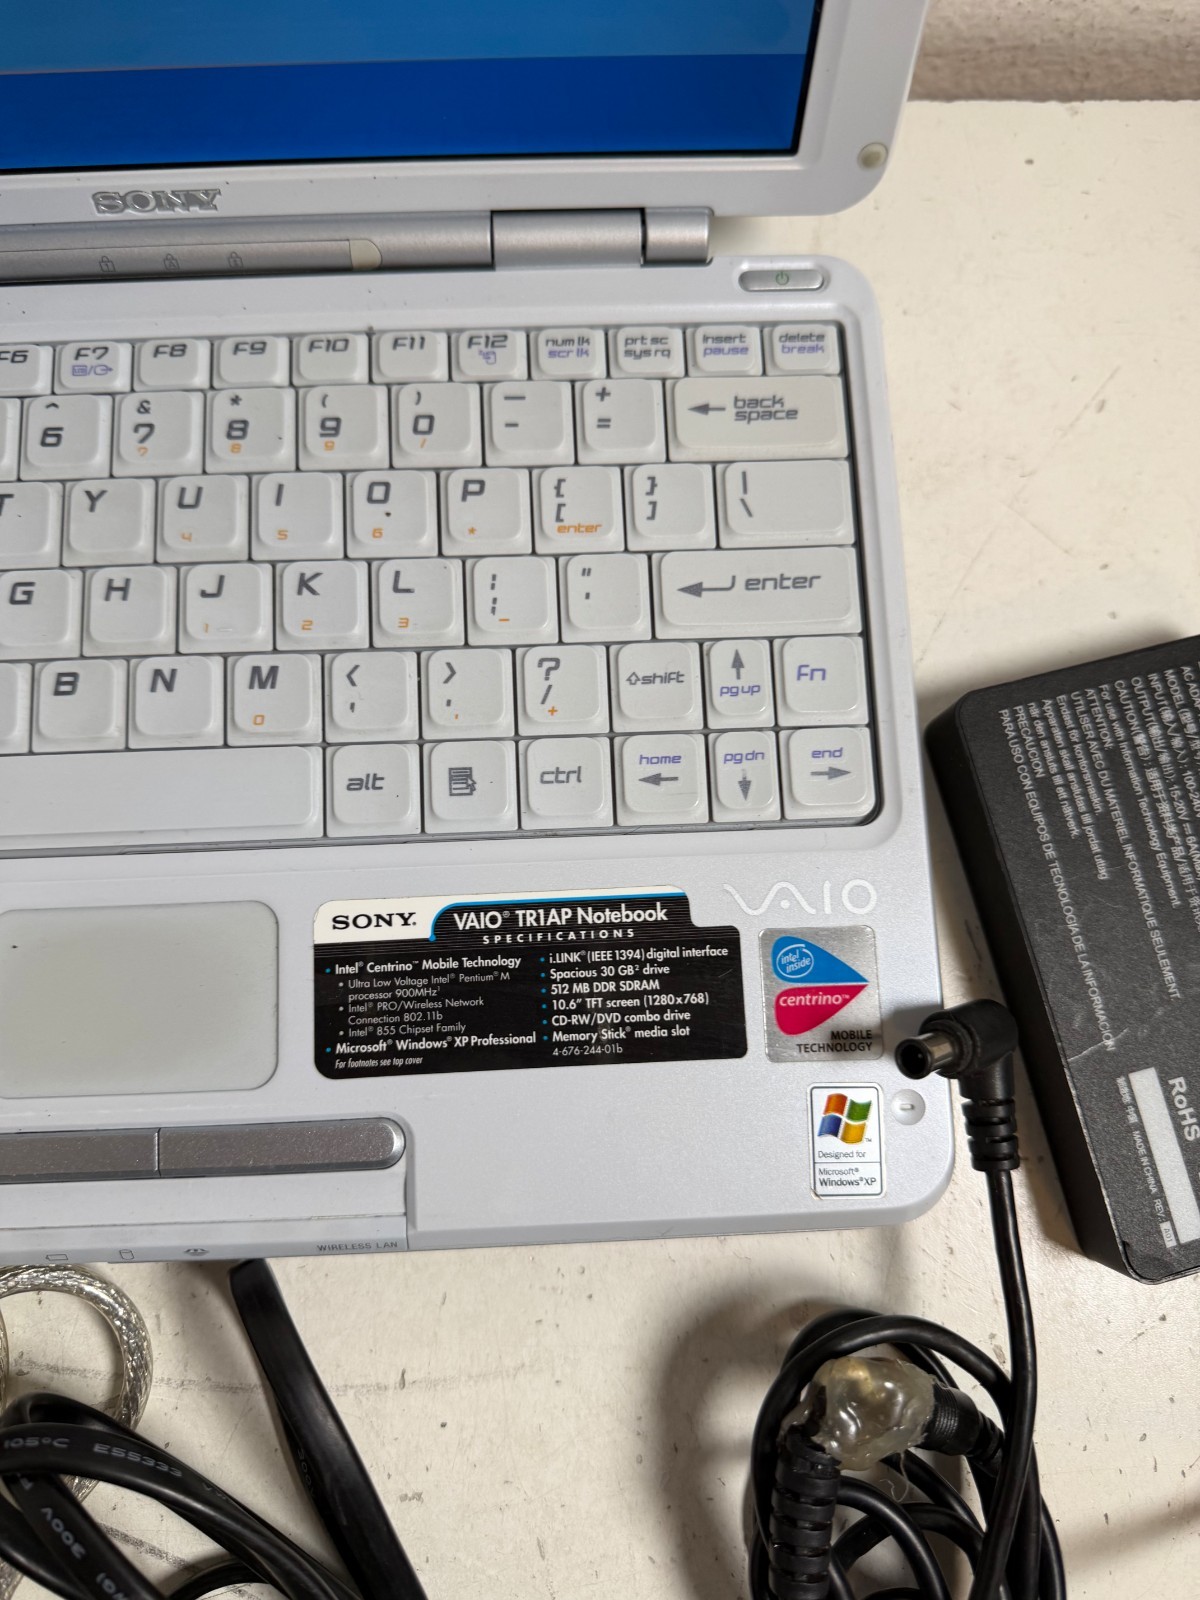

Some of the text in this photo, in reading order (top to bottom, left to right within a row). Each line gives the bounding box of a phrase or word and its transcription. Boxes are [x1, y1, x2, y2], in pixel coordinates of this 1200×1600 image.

[92, 189, 220, 214] SONY
[308, 339, 349, 352] F10
[393, 337, 426, 350] F11
[467, 335, 509, 349] F12
[545, 336, 591, 347] num lk
[624, 336, 669, 347] prt sc
[702, 333, 746, 344] insert
[779, 333, 825, 343] delete
[75, 347, 109, 361] F7
[153, 344, 187, 357] F8
[233, 342, 267, 355] F9
[548, 347, 590, 358] scr lk
[624, 348, 671, 360] sys rq
[703, 346, 749, 357] pause
[781, 343, 825, 353] break
[734, 395, 784, 409] back
[735, 408, 798, 424] space
[133, 423, 155, 443] 7
[226, 420, 249, 440] 8
[319, 417, 341, 437] 9
[41, 427, 64, 448] 6
[177, 487, 202, 509] U
[461, 479, 485, 501] P
[84, 490, 107, 512] Y
[557, 523, 601, 534] enter
[105, 578, 131, 601] H
[200, 575, 225, 598] J
[297, 572, 322, 595] K
[745, 573, 821, 591] enter
[9, 582, 35, 605] G
[150, 669, 177, 692] N
[248, 666, 278, 689] M
[641, 671, 685, 685] shift
[796, 665, 826, 681] Fn
[53, 672, 79, 696] B
[719, 683, 761, 697] pg up
[1099, 684, 1112, 701] For
[1071, 691, 1094, 740] UTILISER
[1105, 702, 1117, 719] use
[1112, 721, 1127, 740] with
[1013, 705, 1045, 778] PRECAUCION
[639, 754, 682, 766] home
[723, 749, 764, 764] pg dn
[812, 747, 843, 759] end
[1087, 740, 1104, 770] AVEC
[540, 767, 582, 785] ctrl
[1118, 741, 1145, 795] Information
[346, 773, 384, 791] alt
[1097, 770, 1111, 788] DU
[1103, 788, 1129, 843] MATERIEL
[1134, 795, 1164, 852] Technology
[998, 709, 1117, 1051] PARA USO CON EQUIPOS DE TECNOLOGIA DE LA INFORMACION
[1121, 843, 1157, 929] INFORMATIQUE
[723, 879, 877, 915] VAIO
[516, 908, 572, 927] TR1AP
[577, 902, 668, 924] Notebook
[482, 928, 634, 944] SPECIFICATIONS
[588, 951, 613, 963] (IEEE
[616, 949, 645, 960] 1394)
[647, 947, 680, 960] digital
[682, 945, 728, 958] interface
[780, 951, 800, 965] intel
[422, 958, 459, 970] Mobile
[462, 955, 521, 969] Technology
[786, 956, 811, 974] inside
[348, 979, 370, 988] Ultra
[373, 978, 391, 987] Low
[394, 976, 428, 989] Voltage
[501, 972, 510, 980] M
[550, 968, 597, 981] Spacious
[601, 966, 615, 976] 30
[643, 964, 670, 975] drive
[551, 979, 660, 995] 512 MB DDR SDRAM
[348, 992, 392, 1003] processor
[377, 999, 442, 1012] PRO/Wireless
[446, 997, 484, 1007] Network
[586, 998, 603, 1008] TFT
[606, 998, 640, 1008] screen
[644, 992, 709, 1007] (1280x768)
[348, 1013, 443, 1025] Connection 802.11b
[552, 1010, 691, 1026] CD-RW/DVD combo drive
[377, 1026, 396, 1035] 855
[399, 1024, 433, 1037] Chipset
[437, 1022, 466, 1033] Family
[552, 1031, 597, 1043] Memory
[635, 1028, 668, 1038] media
[671, 1026, 690, 1036] slot
[831, 1029, 872, 1041] MOBILE
[454, 1037, 469, 1047] XP
[471, 1031, 536, 1047] Professional
[796, 1042, 873, 1053] TECHNOLOGY
[335, 1056, 423, 1069] For footnotes see top cover
[1168, 1076, 1200, 1142] RoHS
[818, 1150, 866, 1160] Designed for
[1132, 1130, 1159, 1193] MADE IN CHINA
[864, 1177, 876, 1186] XP
[317, 1241, 398, 1252] WIRELESS LAN
